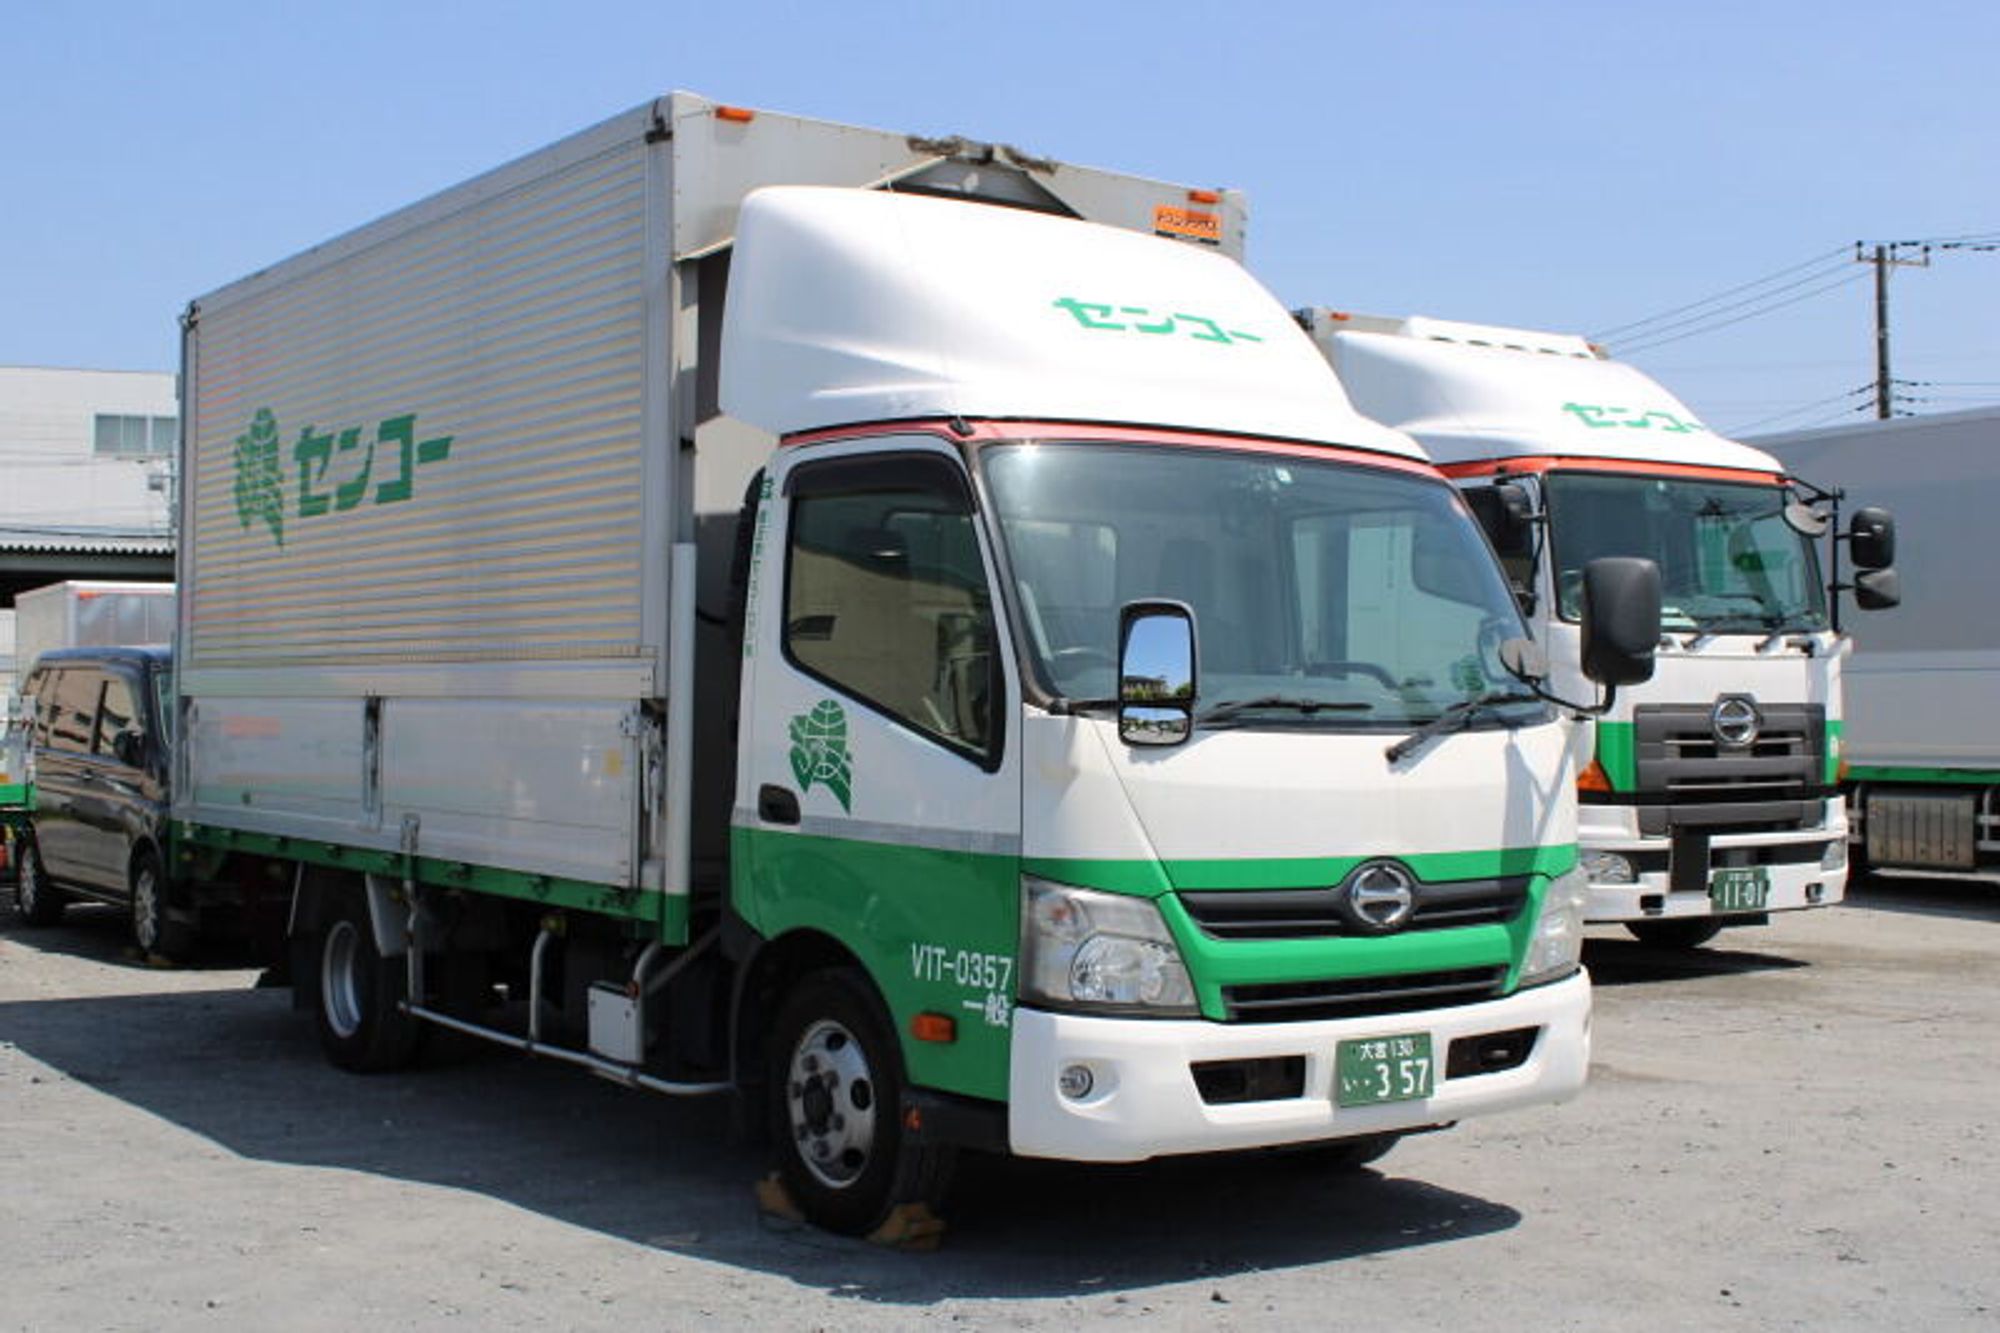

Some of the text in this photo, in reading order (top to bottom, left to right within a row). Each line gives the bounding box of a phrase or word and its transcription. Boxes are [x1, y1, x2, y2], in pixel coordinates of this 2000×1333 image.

[1053, 298, 1263, 344] センコー
[294, 413, 454, 518] センコー
[962, 992, 1011, 1028] 一般
[1359, 1042, 1388, 1061] 大宮
